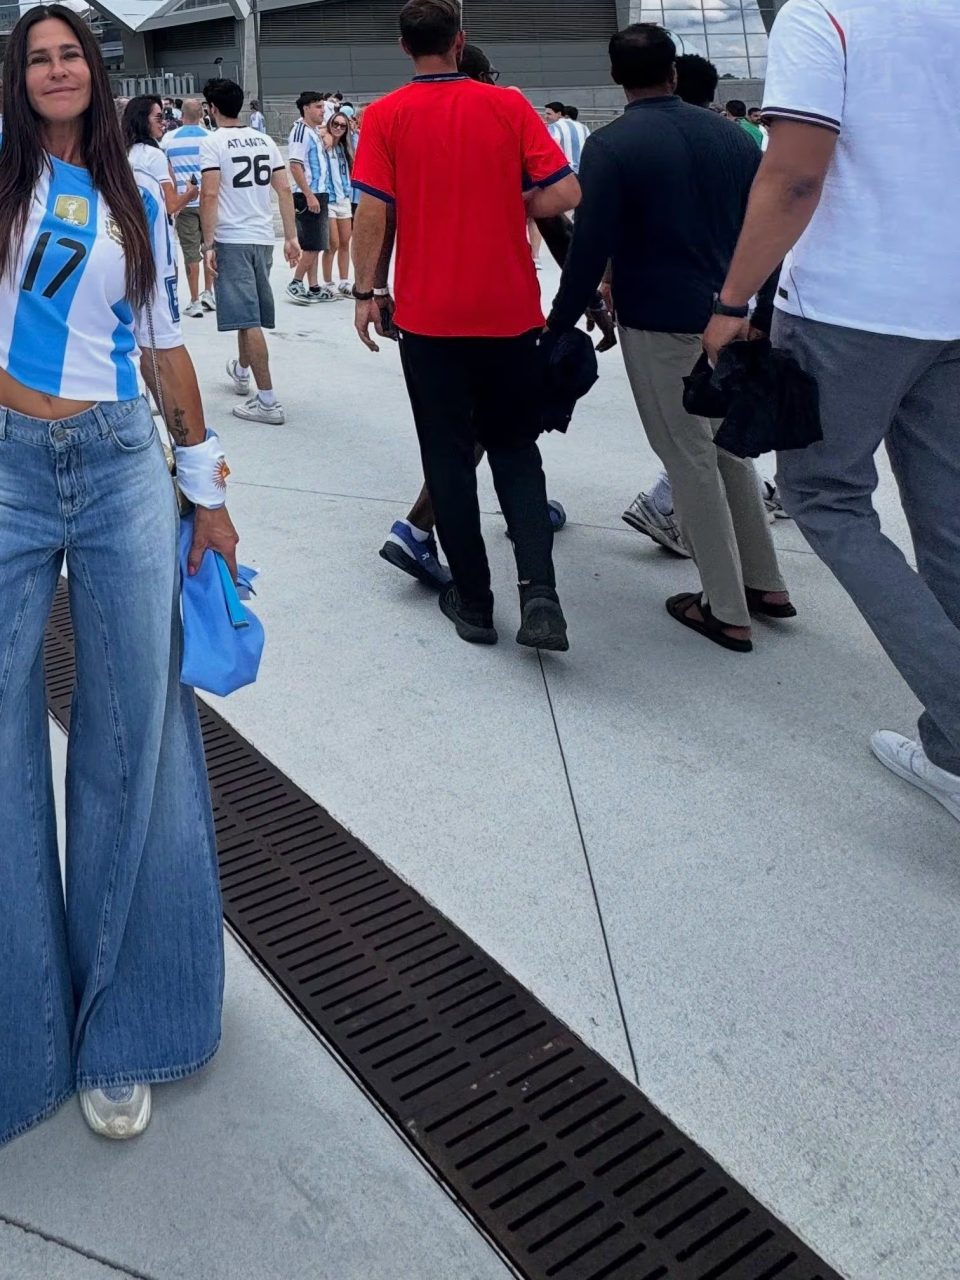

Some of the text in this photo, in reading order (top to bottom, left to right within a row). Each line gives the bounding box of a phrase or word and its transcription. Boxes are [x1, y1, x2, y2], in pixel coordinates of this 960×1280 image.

[227, 137, 269, 150] ATLANTA
[231, 154, 271, 189] 26
[22, 231, 87, 300] 17
